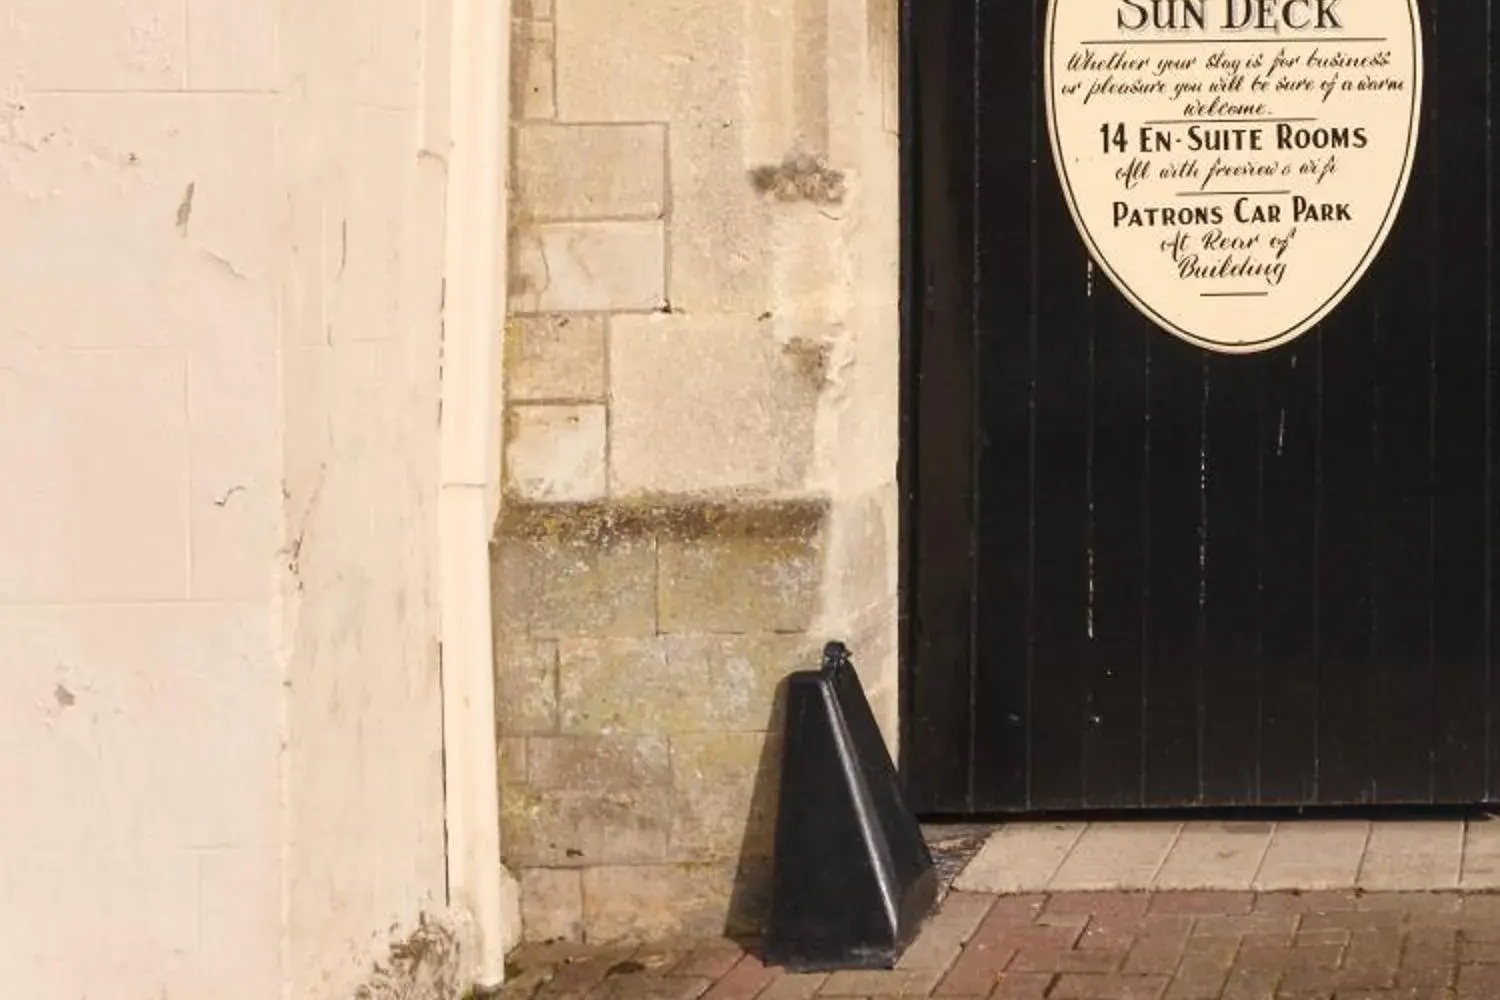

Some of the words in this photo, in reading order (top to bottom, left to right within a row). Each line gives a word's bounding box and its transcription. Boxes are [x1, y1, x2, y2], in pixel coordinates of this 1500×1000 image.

[1067, 48, 1150, 71] Whether
[1152, 56, 1197, 76] your
[1245, 53, 1263, 68] is
[1266, 48, 1300, 77] for
[1306, 48, 1391, 68] business
[1061, 81, 1081, 95] or
[1083, 74, 1166, 104] pleasure
[1170, 81, 1203, 100] you
[1209, 76, 1244, 91] will
[1251, 74, 1271, 92] be
[1276, 76, 1314, 91] sure
[1320, 72, 1339, 103] of
[1341, 80, 1352, 91] a
[1357, 76, 1405, 91] warm
[1099, 123, 1128, 153] 14
[1277, 125, 1368, 150] ROOMS
[1115, 159, 1151, 189] All
[1159, 159, 1199, 180] with
[1201, 157, 1278, 190] freeview
[1113, 201, 1223, 227] PATRONS
[1234, 197, 1281, 223] CAR
[1292, 196, 1352, 222] PARK
[1160, 230, 1188, 262] At
[1202, 228, 1259, 251] Rear
[1270, 227, 1297, 258] of
[1178, 254, 1288, 285] Building
